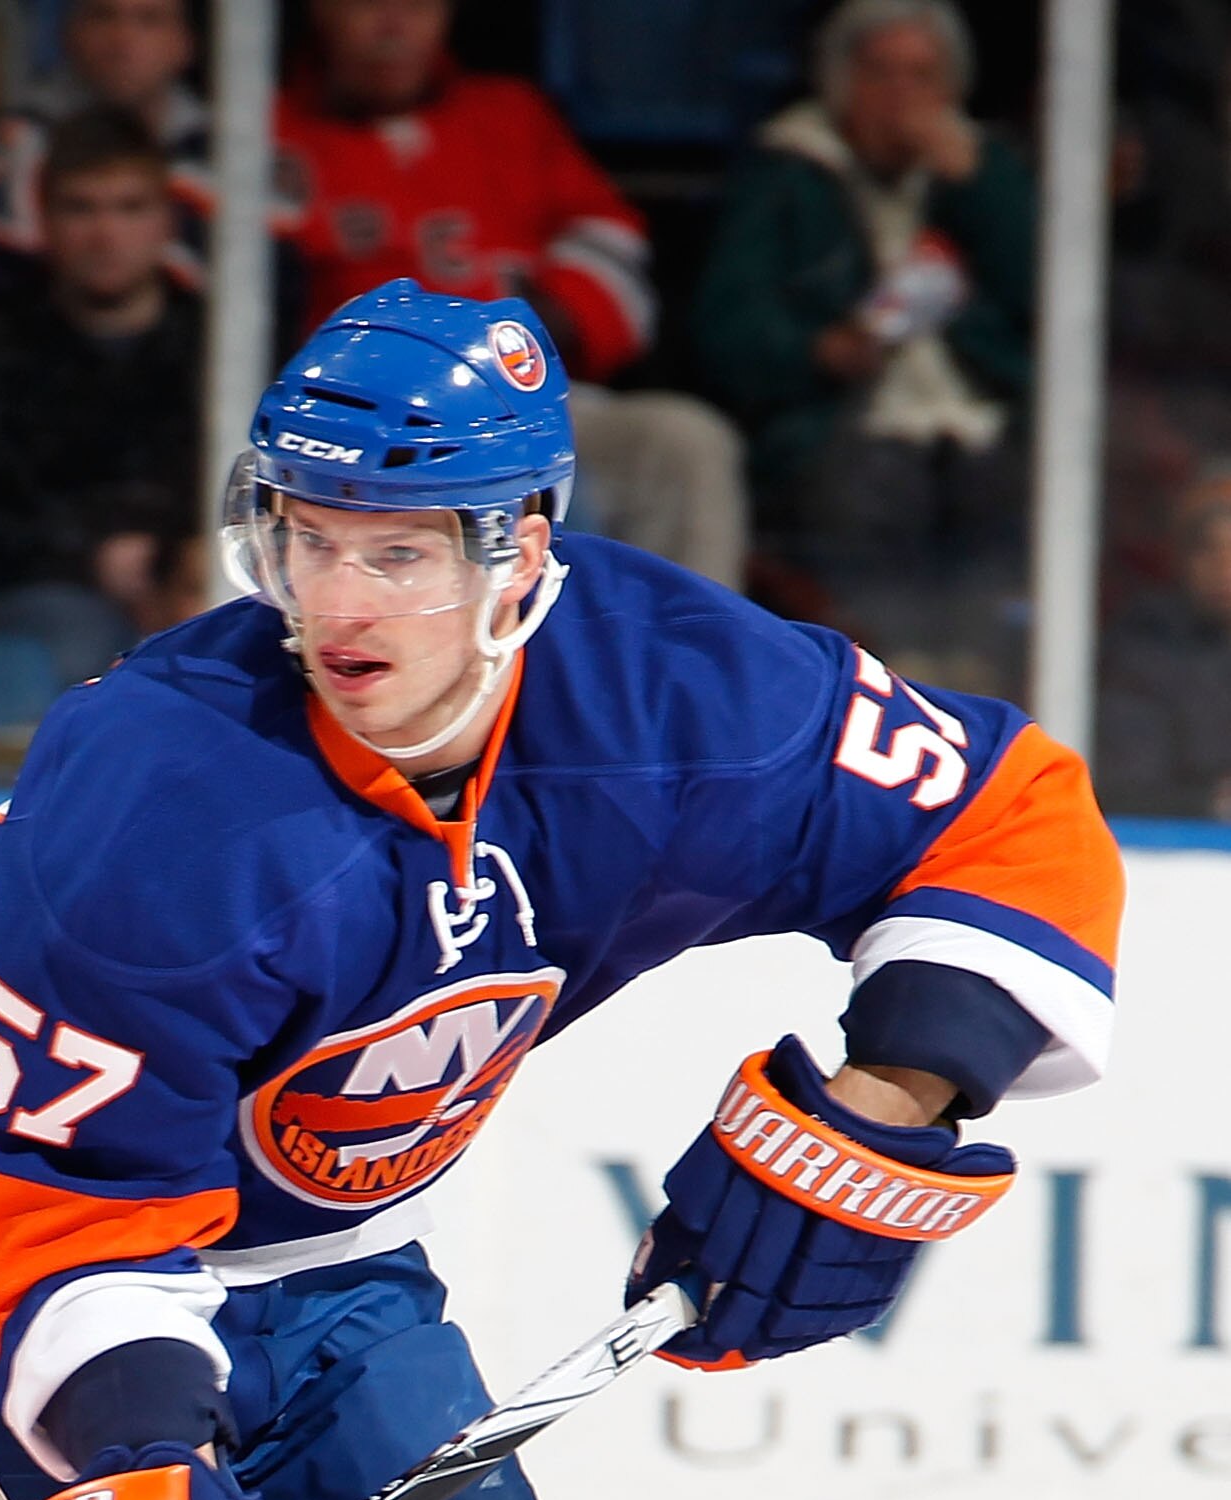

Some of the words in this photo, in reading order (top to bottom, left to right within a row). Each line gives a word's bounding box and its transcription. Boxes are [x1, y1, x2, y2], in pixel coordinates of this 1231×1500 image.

[275, 431, 364, 464] CCM
[340, 993, 538, 1120] NY
[716, 1082, 981, 1232] WARRIOR
